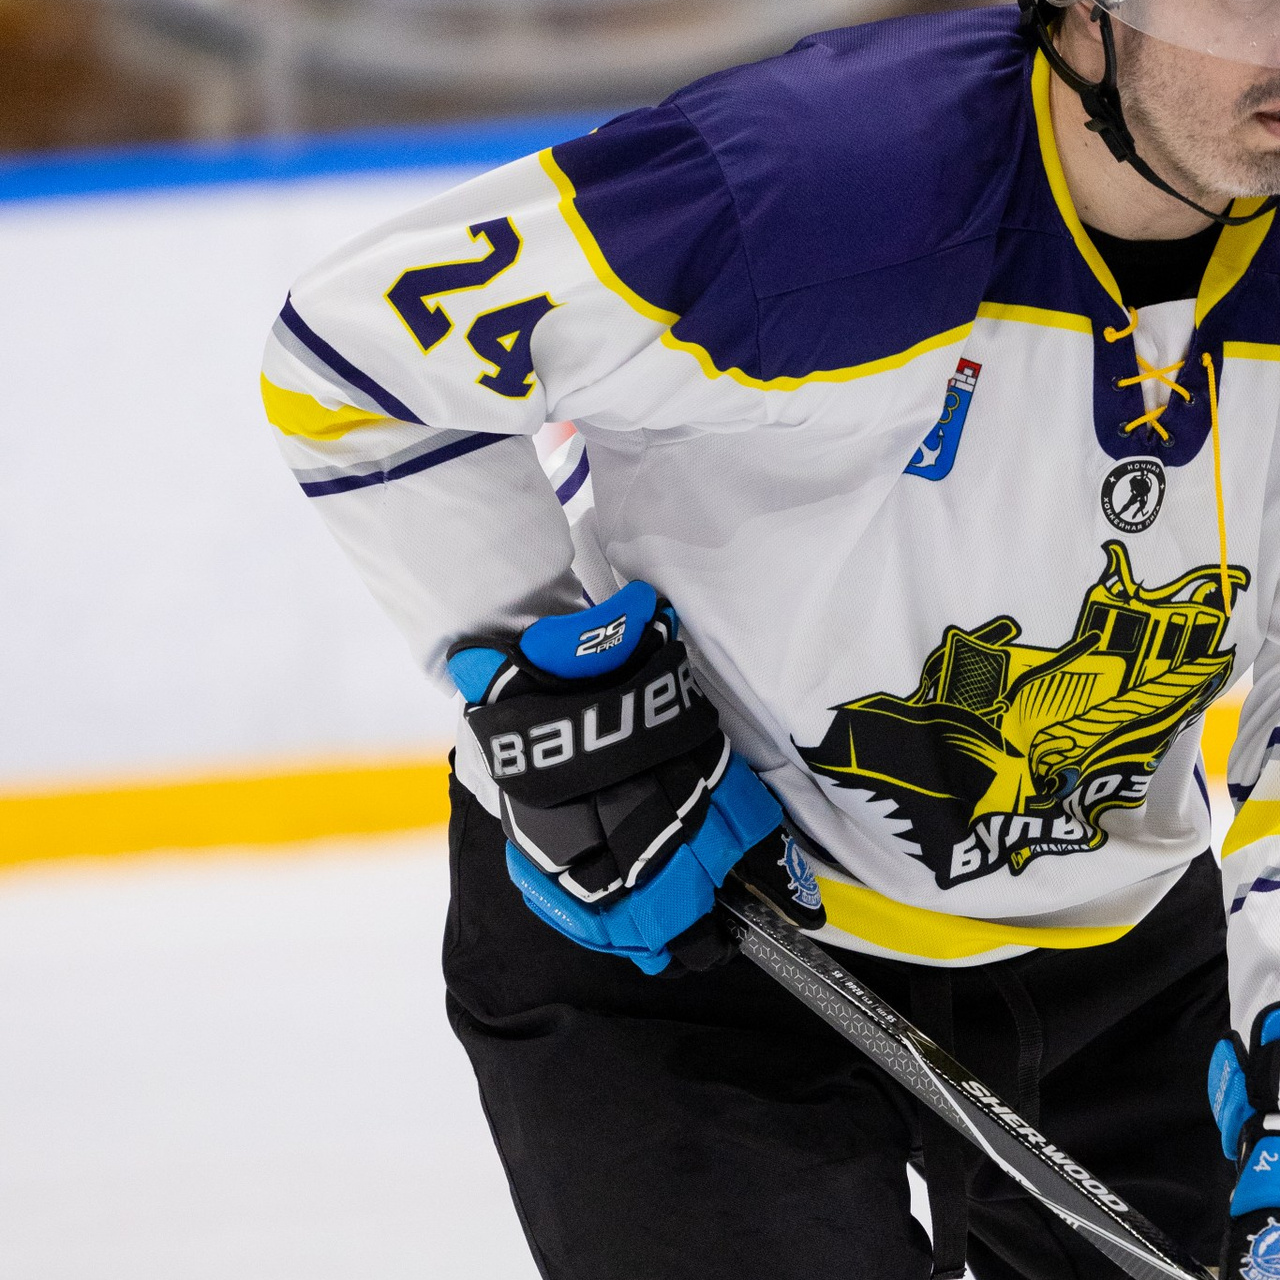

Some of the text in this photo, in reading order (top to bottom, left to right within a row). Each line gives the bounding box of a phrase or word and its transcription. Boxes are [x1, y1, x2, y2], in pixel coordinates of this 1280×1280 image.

[383, 216, 560, 400] 24
[1126, 463, 1160, 473] НОЧНАЯ
[1103, 497, 1160, 531] ХОККЕЙНАЯ ЛИГА
[597, 634, 623, 654] PRO
[1253, 1150, 1279, 1172] 24
